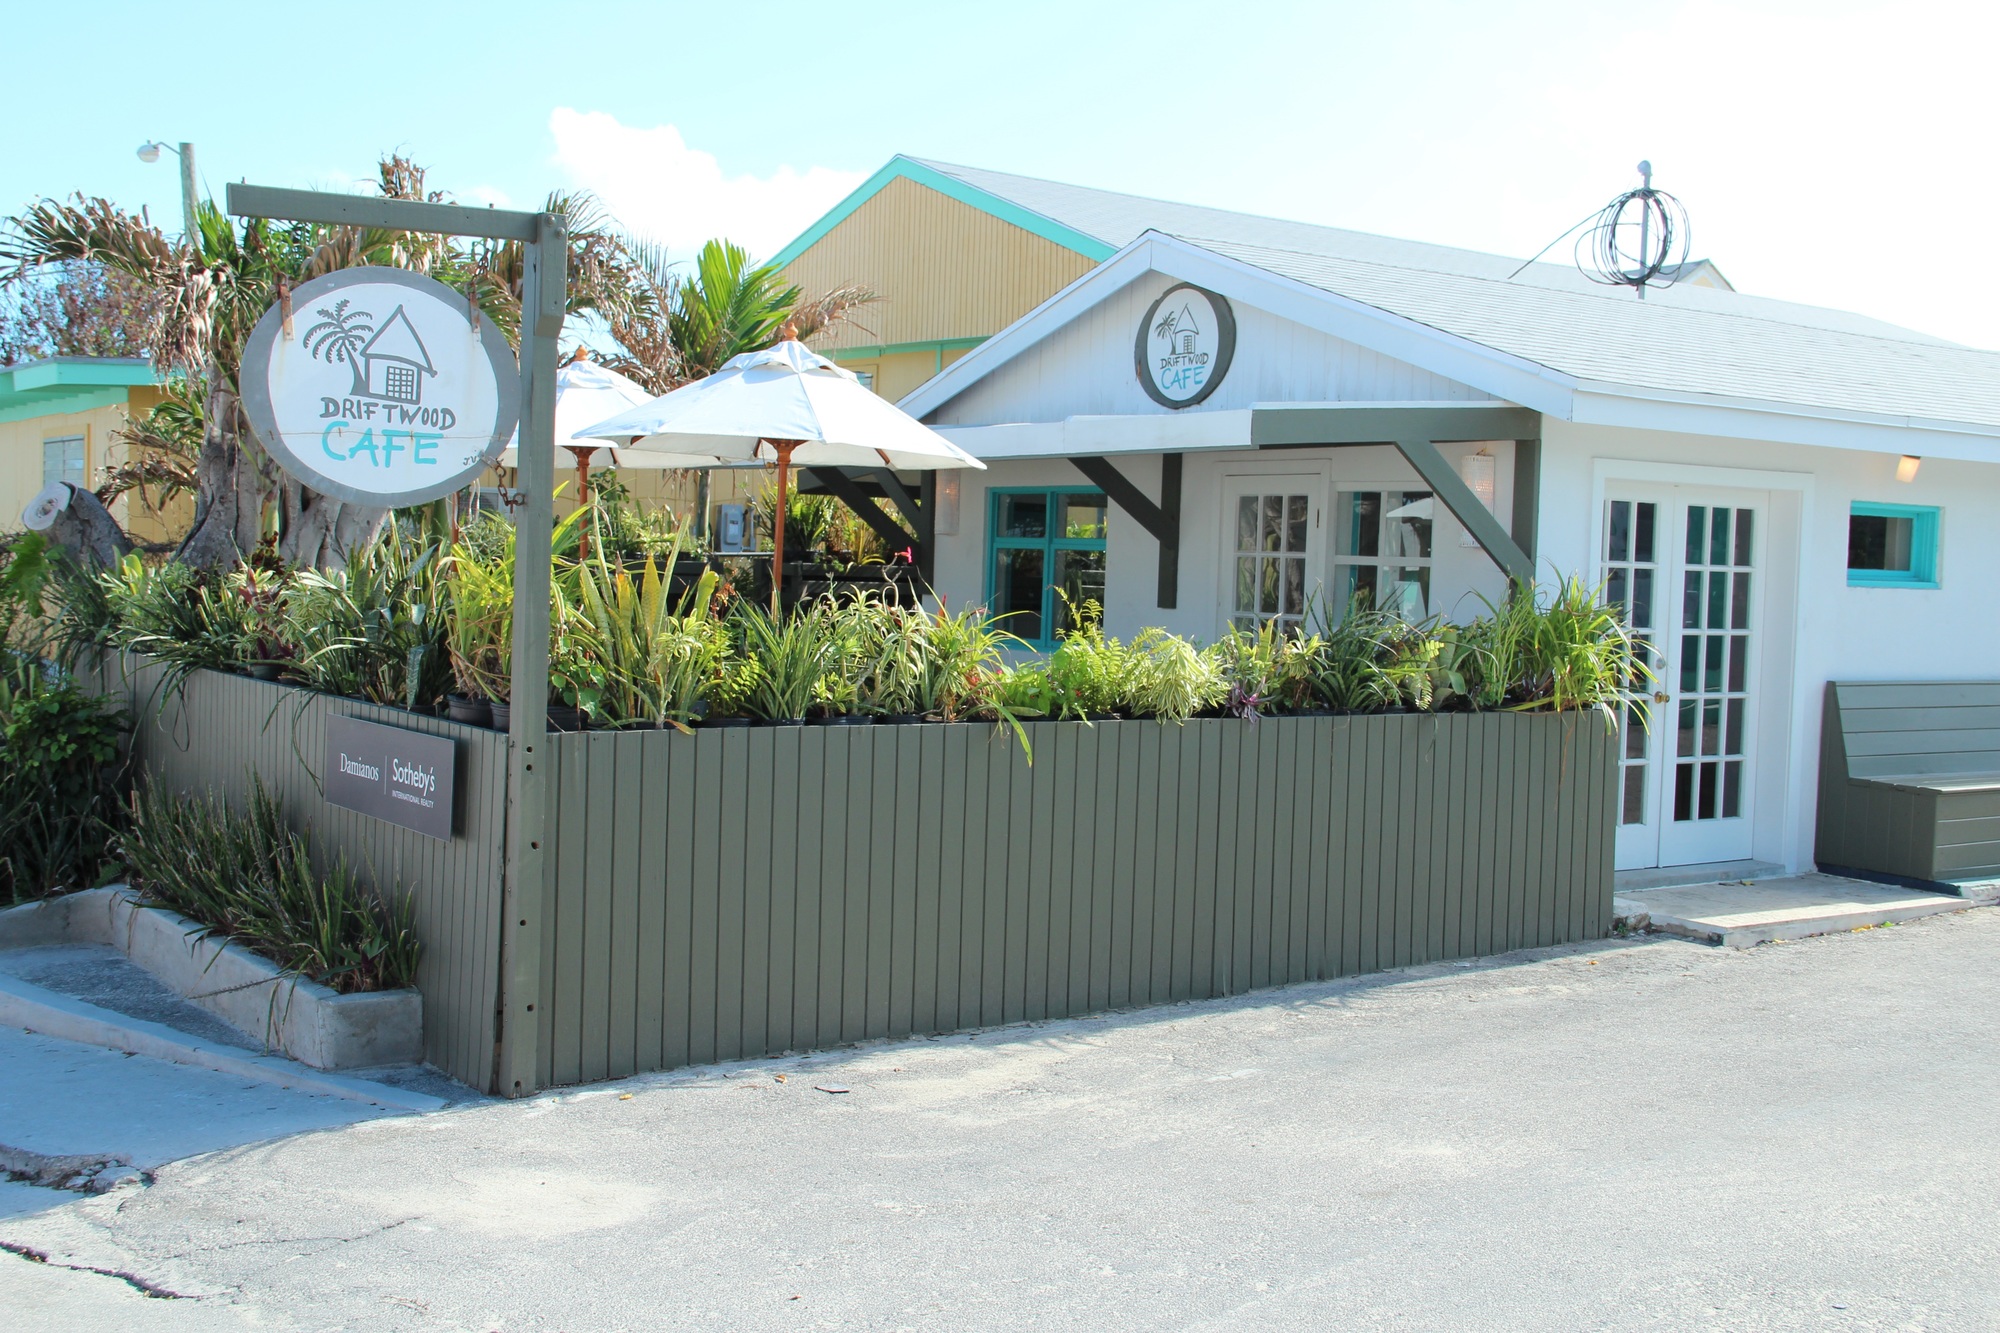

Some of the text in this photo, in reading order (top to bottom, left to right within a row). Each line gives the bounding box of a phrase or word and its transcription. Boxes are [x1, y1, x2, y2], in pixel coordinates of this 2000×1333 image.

[1160, 353, 1209, 369] DRIFTWOOD
[1161, 366, 1205, 389] CAFE
[319, 397, 456, 431] DRIFTWOOD
[322, 421, 444, 468] CAFE
[340, 752, 435, 796] Damianos Sotheby's
[392, 789, 434, 808] INTERNATIONAL REALTY
